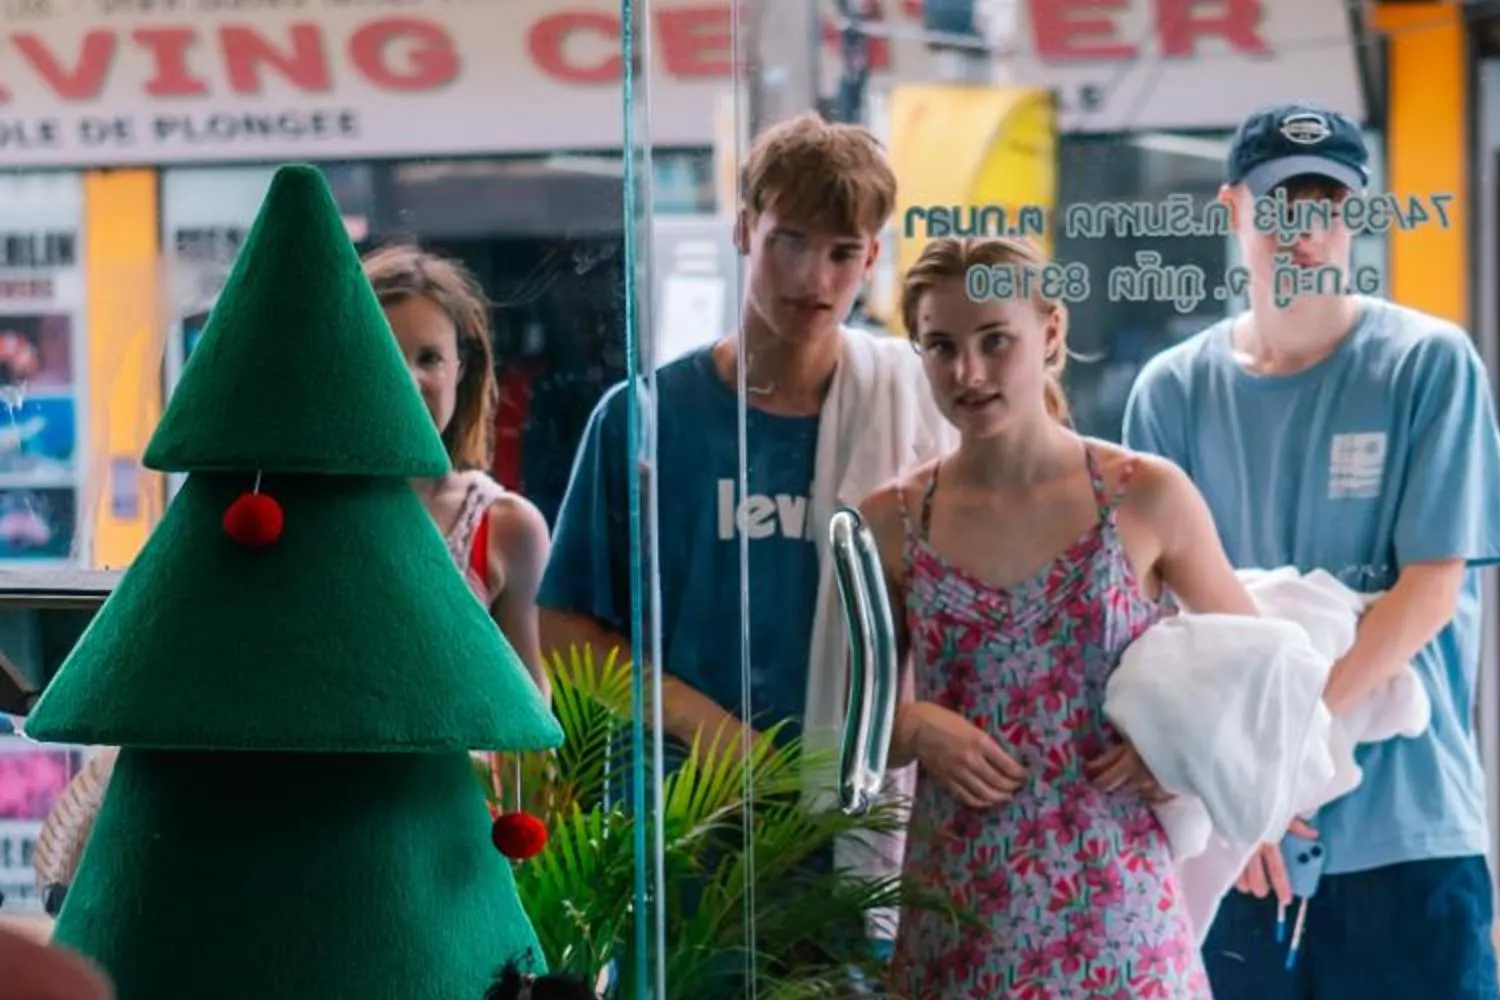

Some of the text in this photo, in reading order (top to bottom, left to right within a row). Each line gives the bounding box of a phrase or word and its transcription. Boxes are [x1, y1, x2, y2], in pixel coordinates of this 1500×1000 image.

[0, 0, 1270, 103] VING CEER
[80, 117, 132, 145] DE
[153, 107, 359, 143] PLONGEE
